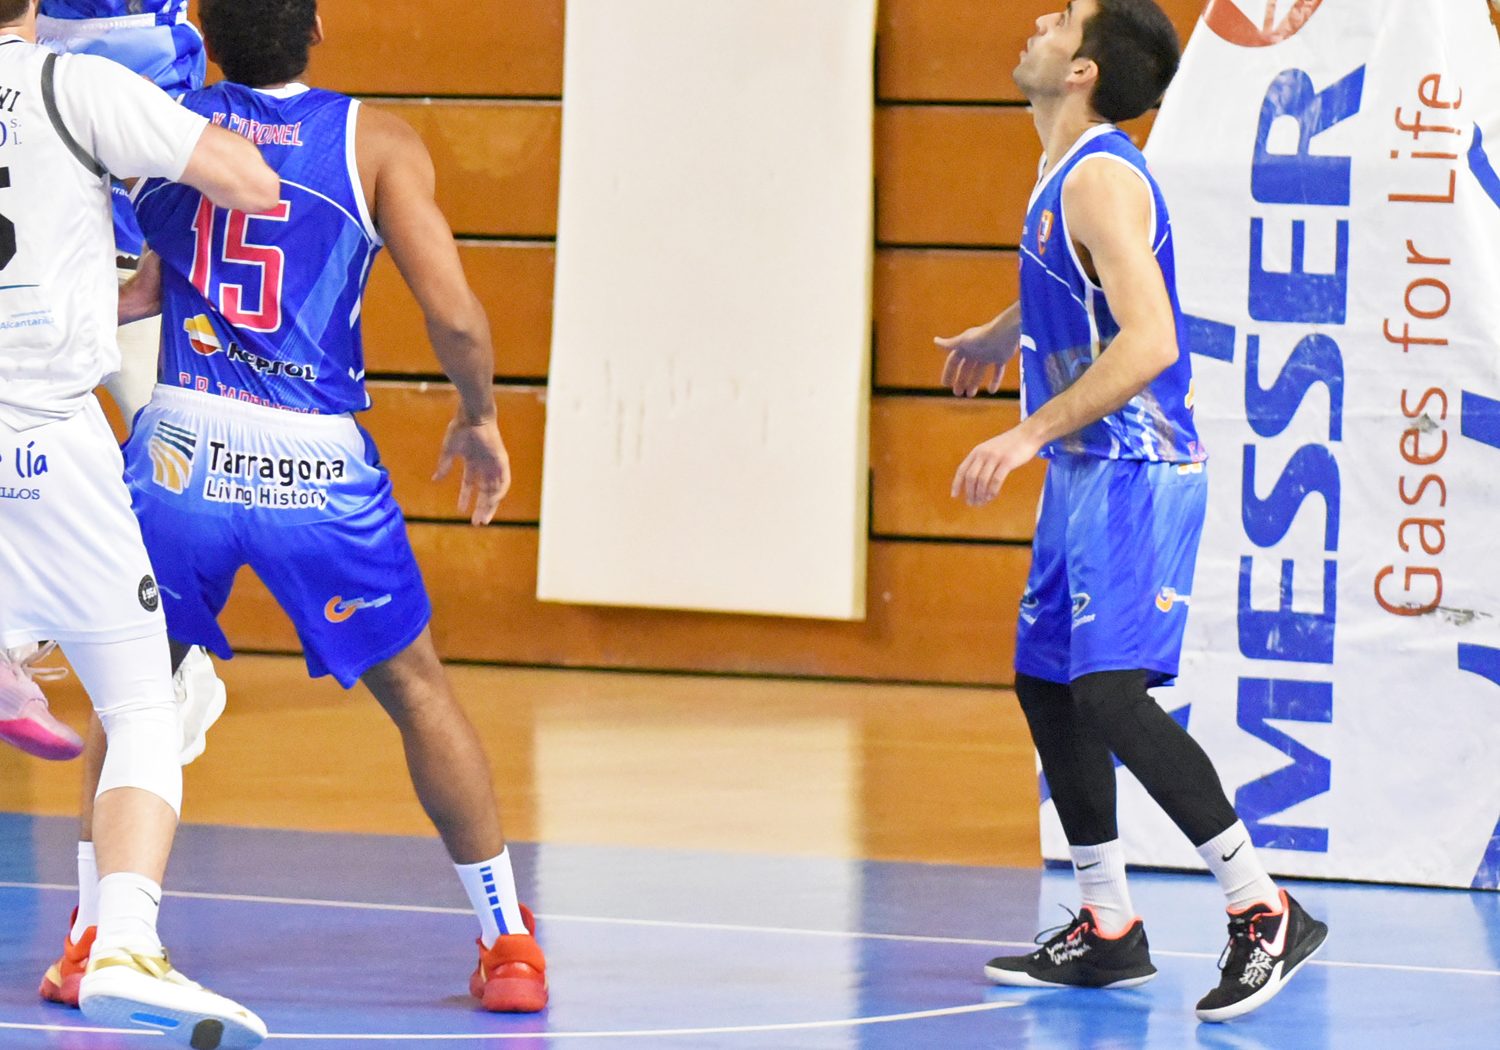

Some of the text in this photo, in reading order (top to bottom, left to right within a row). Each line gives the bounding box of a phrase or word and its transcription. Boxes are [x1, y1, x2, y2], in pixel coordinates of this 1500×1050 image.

[188, 194, 291, 334] 15
[1374, 73, 1463, 617] Gases for Life
[15, 440, 48, 479] lía
[209, 441, 345, 486] Tarragona
[259, 487, 327, 507] History
[1235, 63, 1366, 853] MESSER
